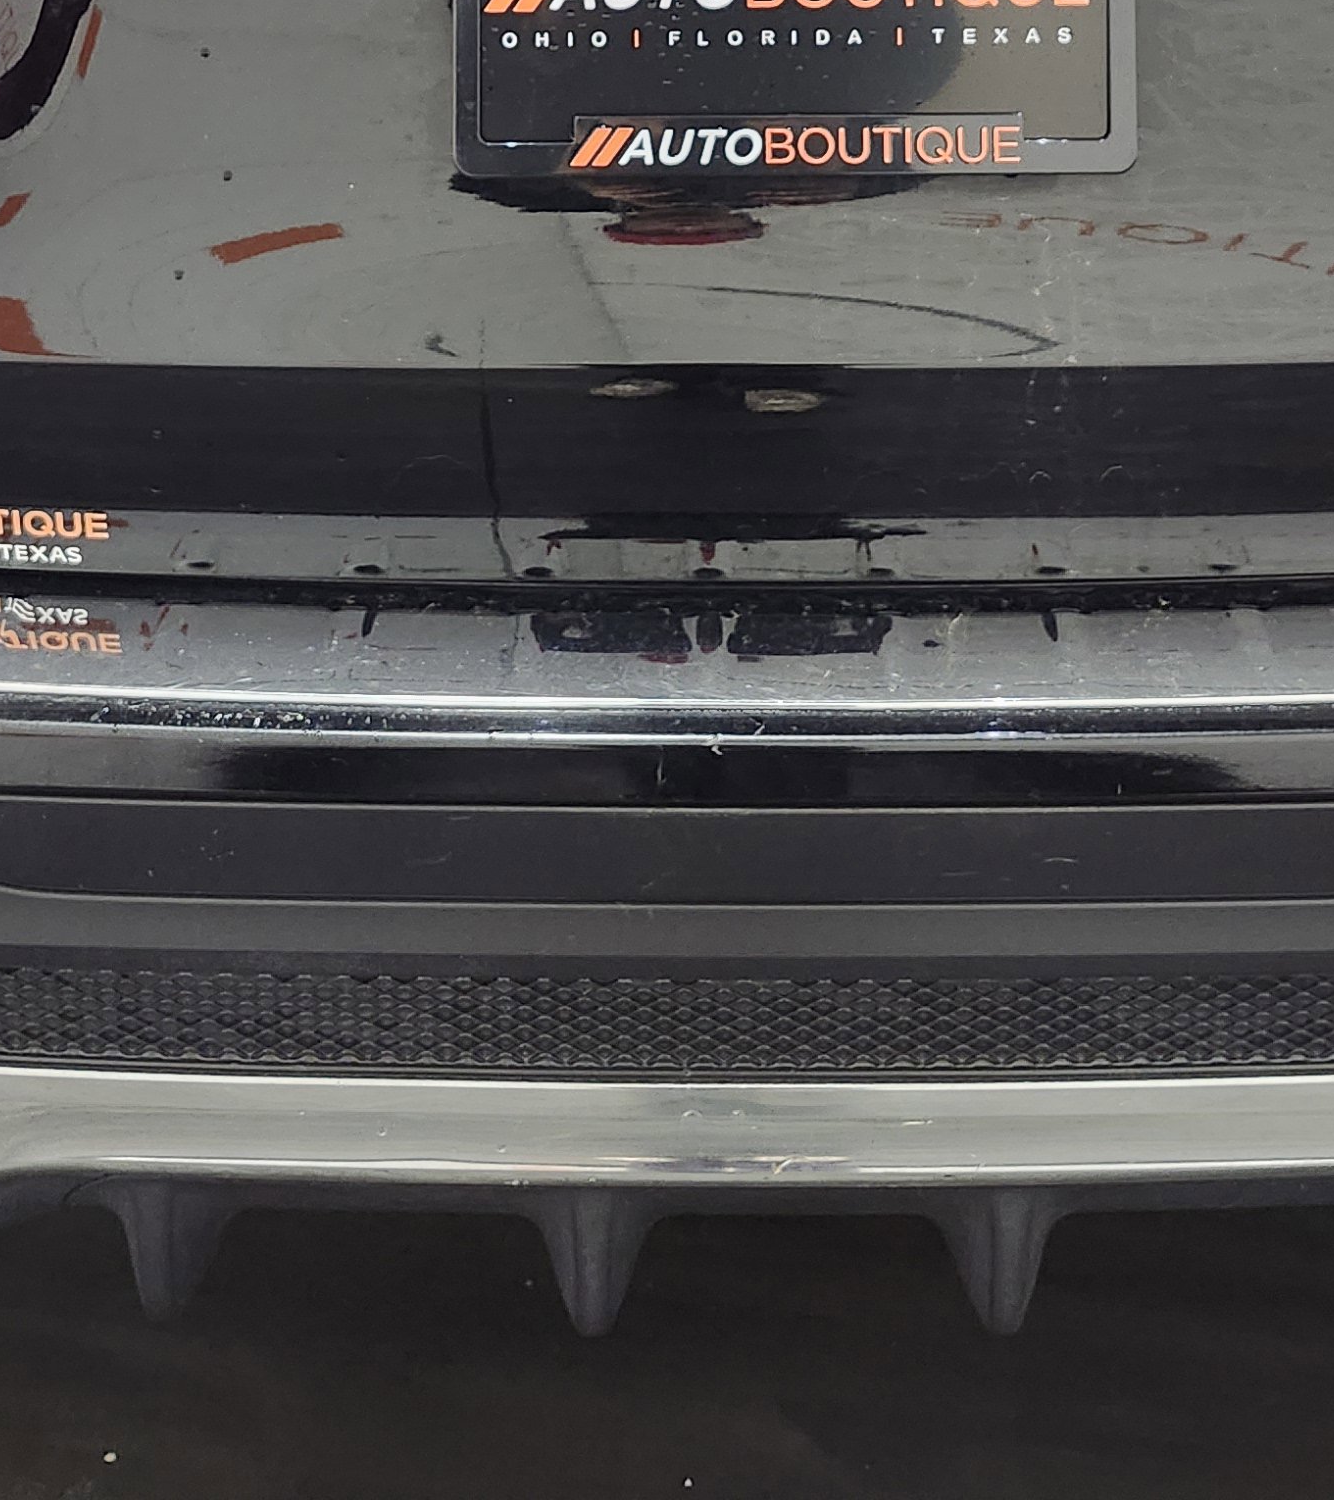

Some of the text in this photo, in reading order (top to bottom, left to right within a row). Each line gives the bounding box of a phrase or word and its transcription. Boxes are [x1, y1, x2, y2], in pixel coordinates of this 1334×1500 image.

[501, 25, 1073, 49] OHIO FLORIDA TEXAS
[616, 124, 1023, 168] AUTOBOUTIQUE
